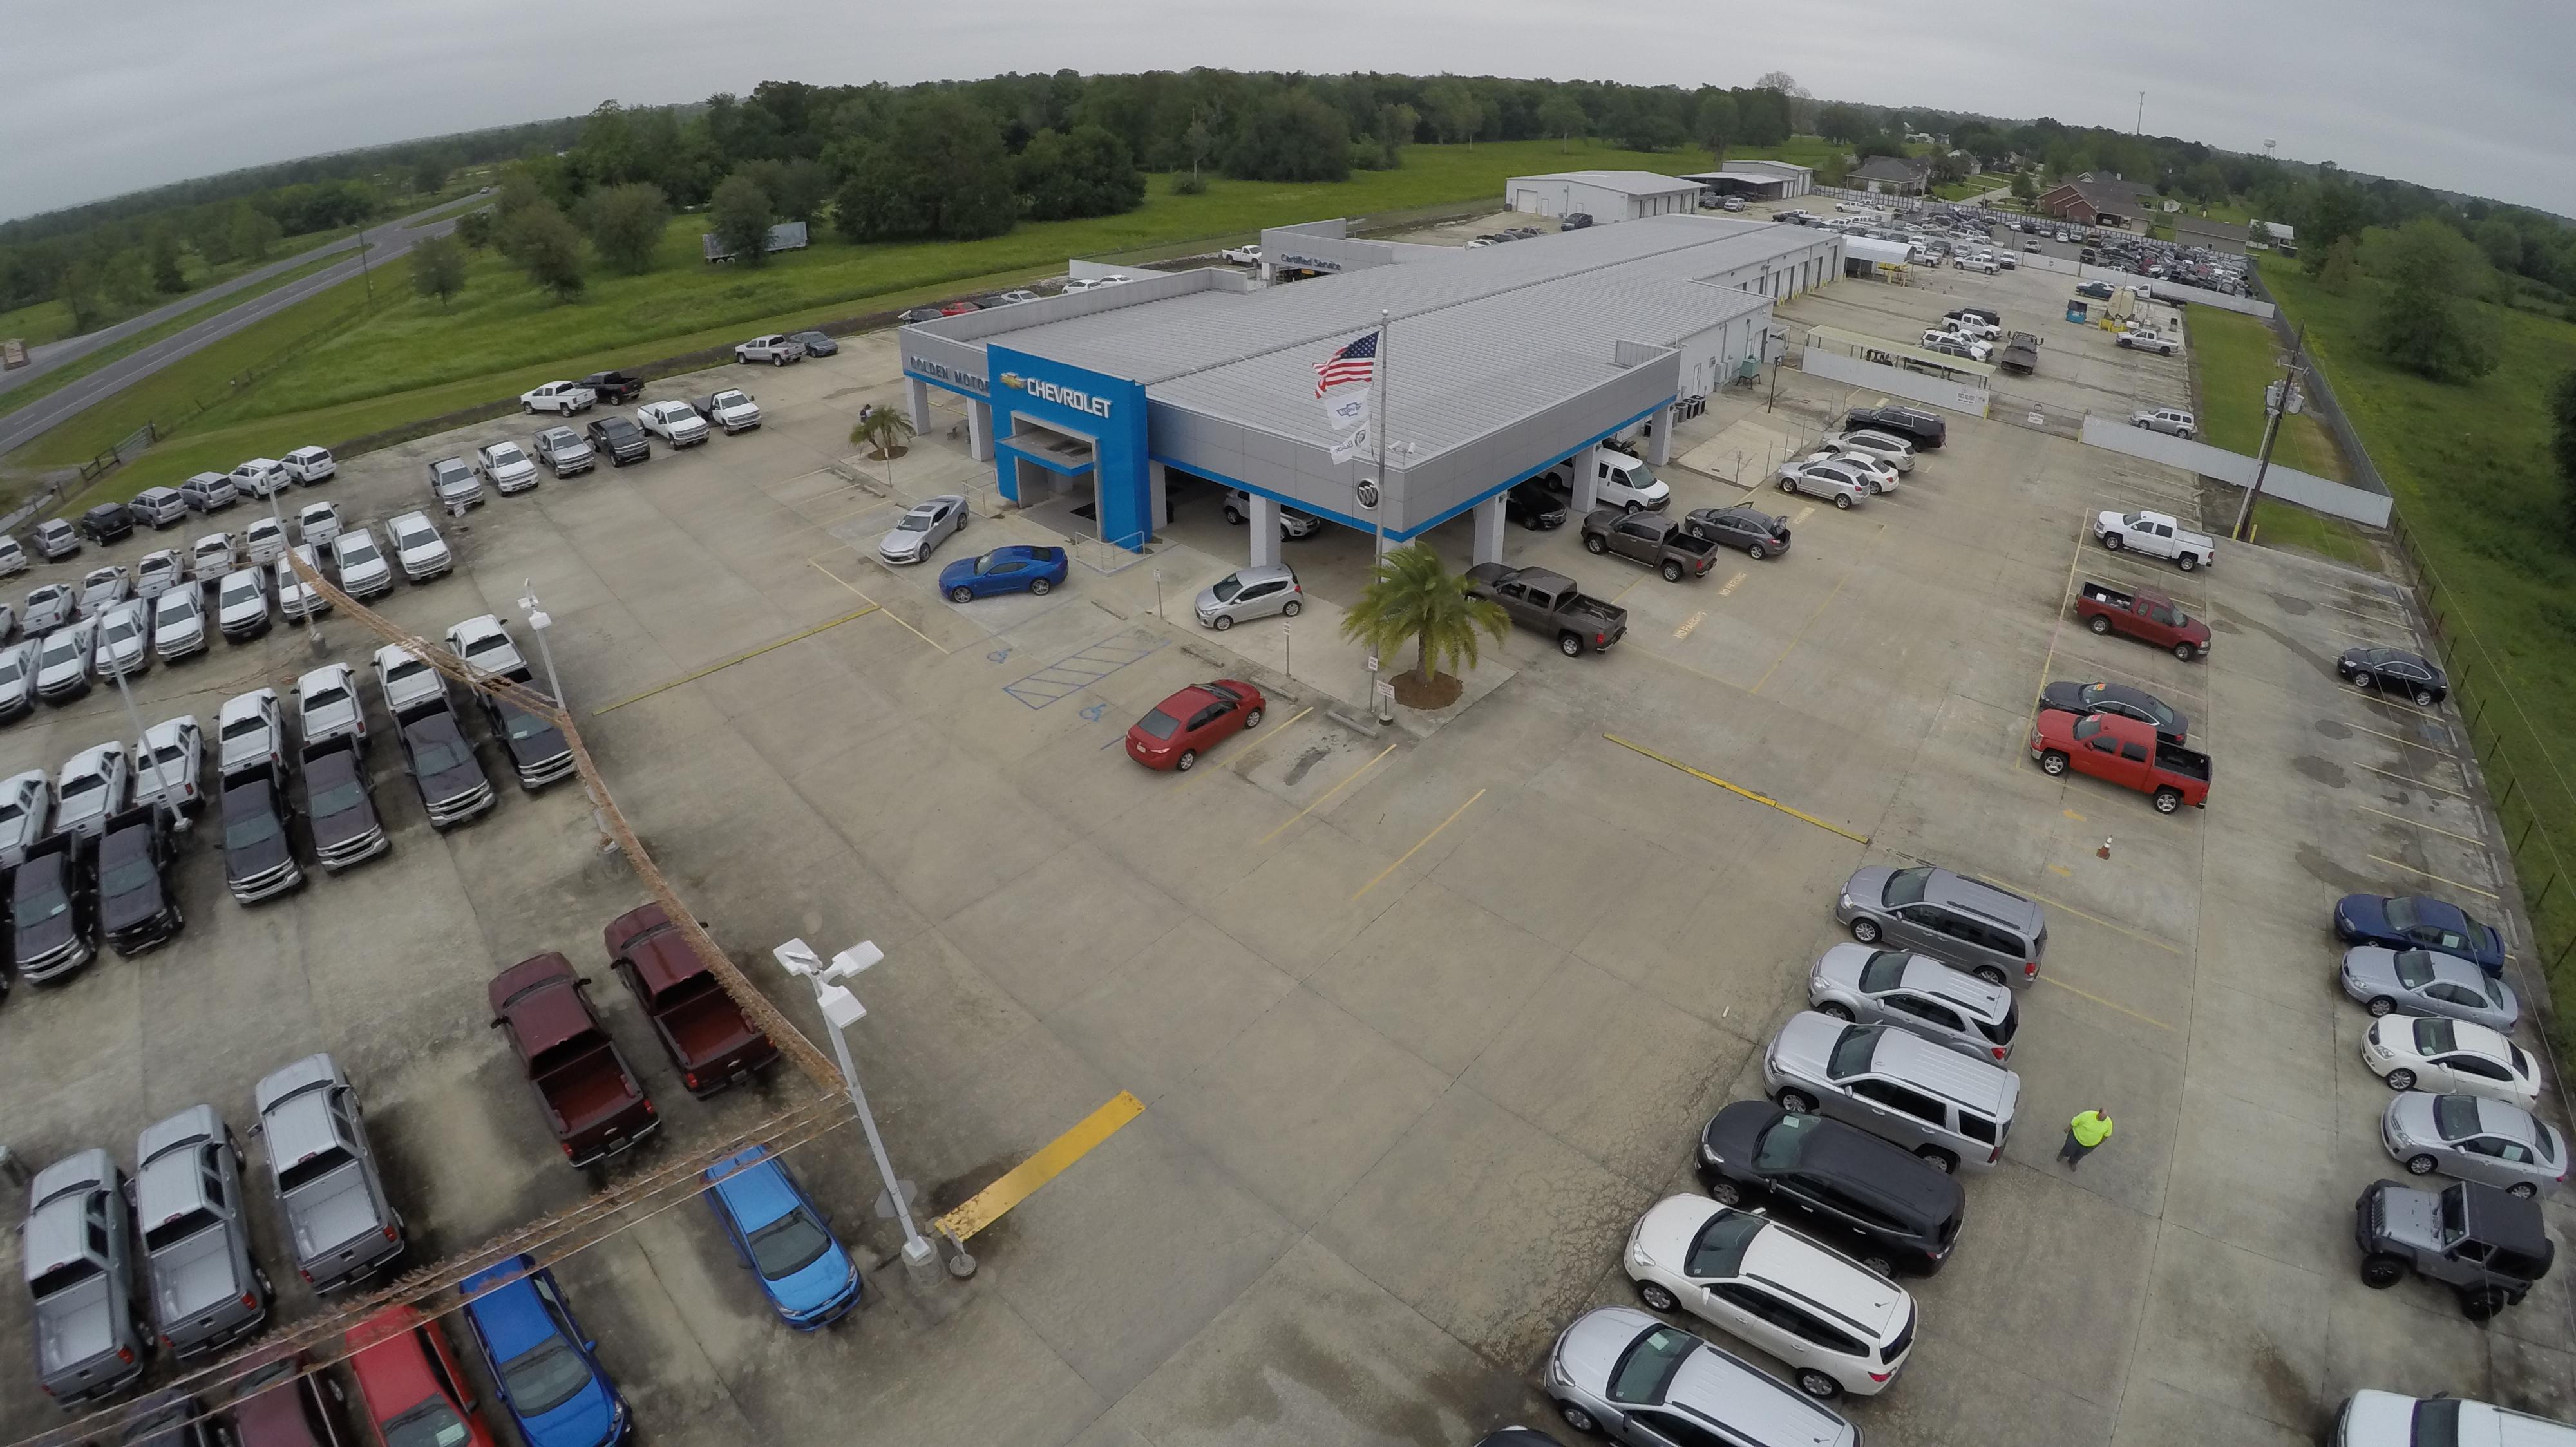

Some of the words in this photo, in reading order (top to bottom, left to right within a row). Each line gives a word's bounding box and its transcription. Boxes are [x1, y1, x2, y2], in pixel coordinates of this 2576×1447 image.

[1281, 253, 1312, 266] Certified
[1314, 258, 1341, 270] Service
[910, 356, 949, 379] GOLDEN
[1027, 377, 1112, 419] CHEVROLET
